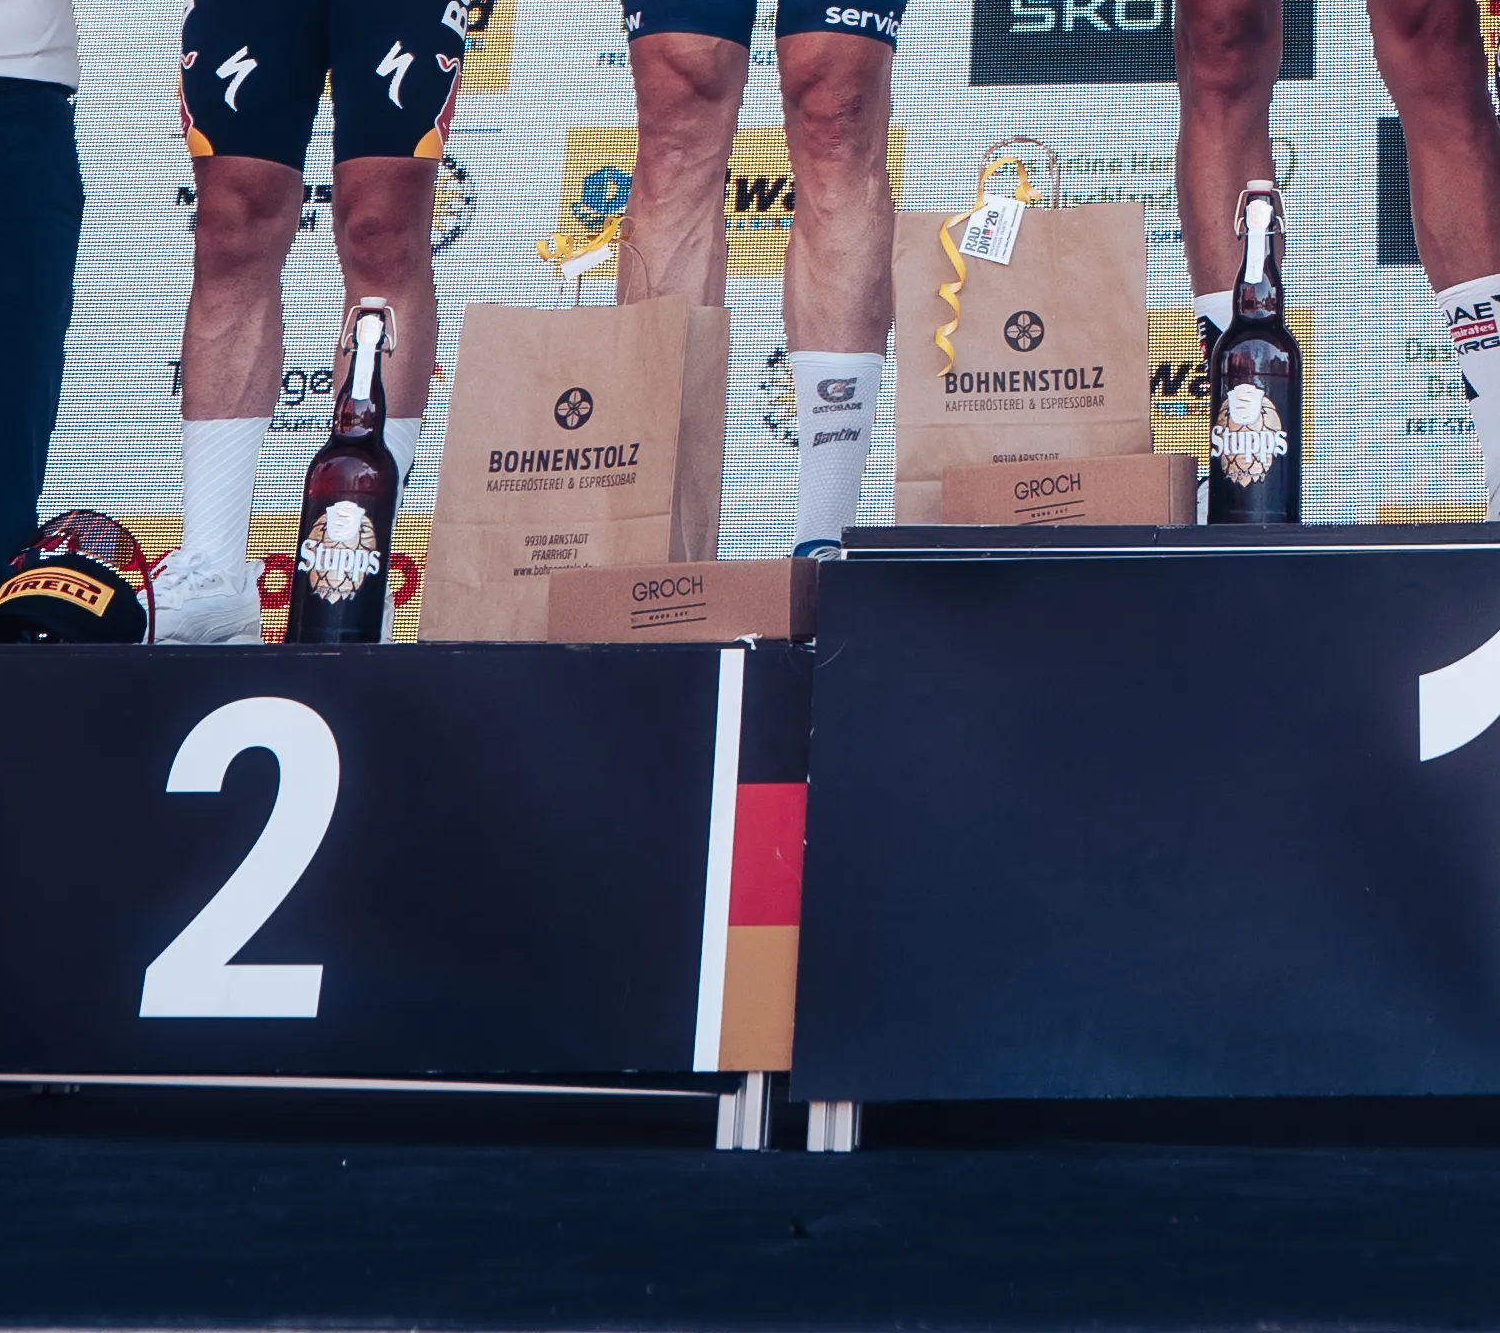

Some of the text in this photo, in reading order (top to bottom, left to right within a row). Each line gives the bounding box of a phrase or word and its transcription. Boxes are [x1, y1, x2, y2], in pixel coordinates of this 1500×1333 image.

[825, 5, 901, 38] servic
[964, 226, 981, 251] RAD
[1452, 321, 1495, 338] mirates
[945, 366, 1105, 394] BOHNENSTOLZ
[812, 401, 863, 414] GATORADE
[944, 395, 1105, 413] KAFFEERÖSTEREI & ESPRESSOBAR
[812, 426, 862, 448] Santini
[1210, 425, 1288, 464] Stupps
[488, 442, 640, 474] BOHNENSTOLZ
[486, 471, 637, 493] KAFFEERÖSTEREI & ESPRESSOBAR
[1014, 472, 1082, 501] GROCH
[524, 533, 589, 547] 99310 ARNSTADT
[298, 538, 382, 584] Stupps
[531, 549, 572, 562] PFARRHOF
[0, 573, 102, 607] PIRELLI
[632, 575, 705, 602] GROCH
[139, 696, 340, 1018] 2
